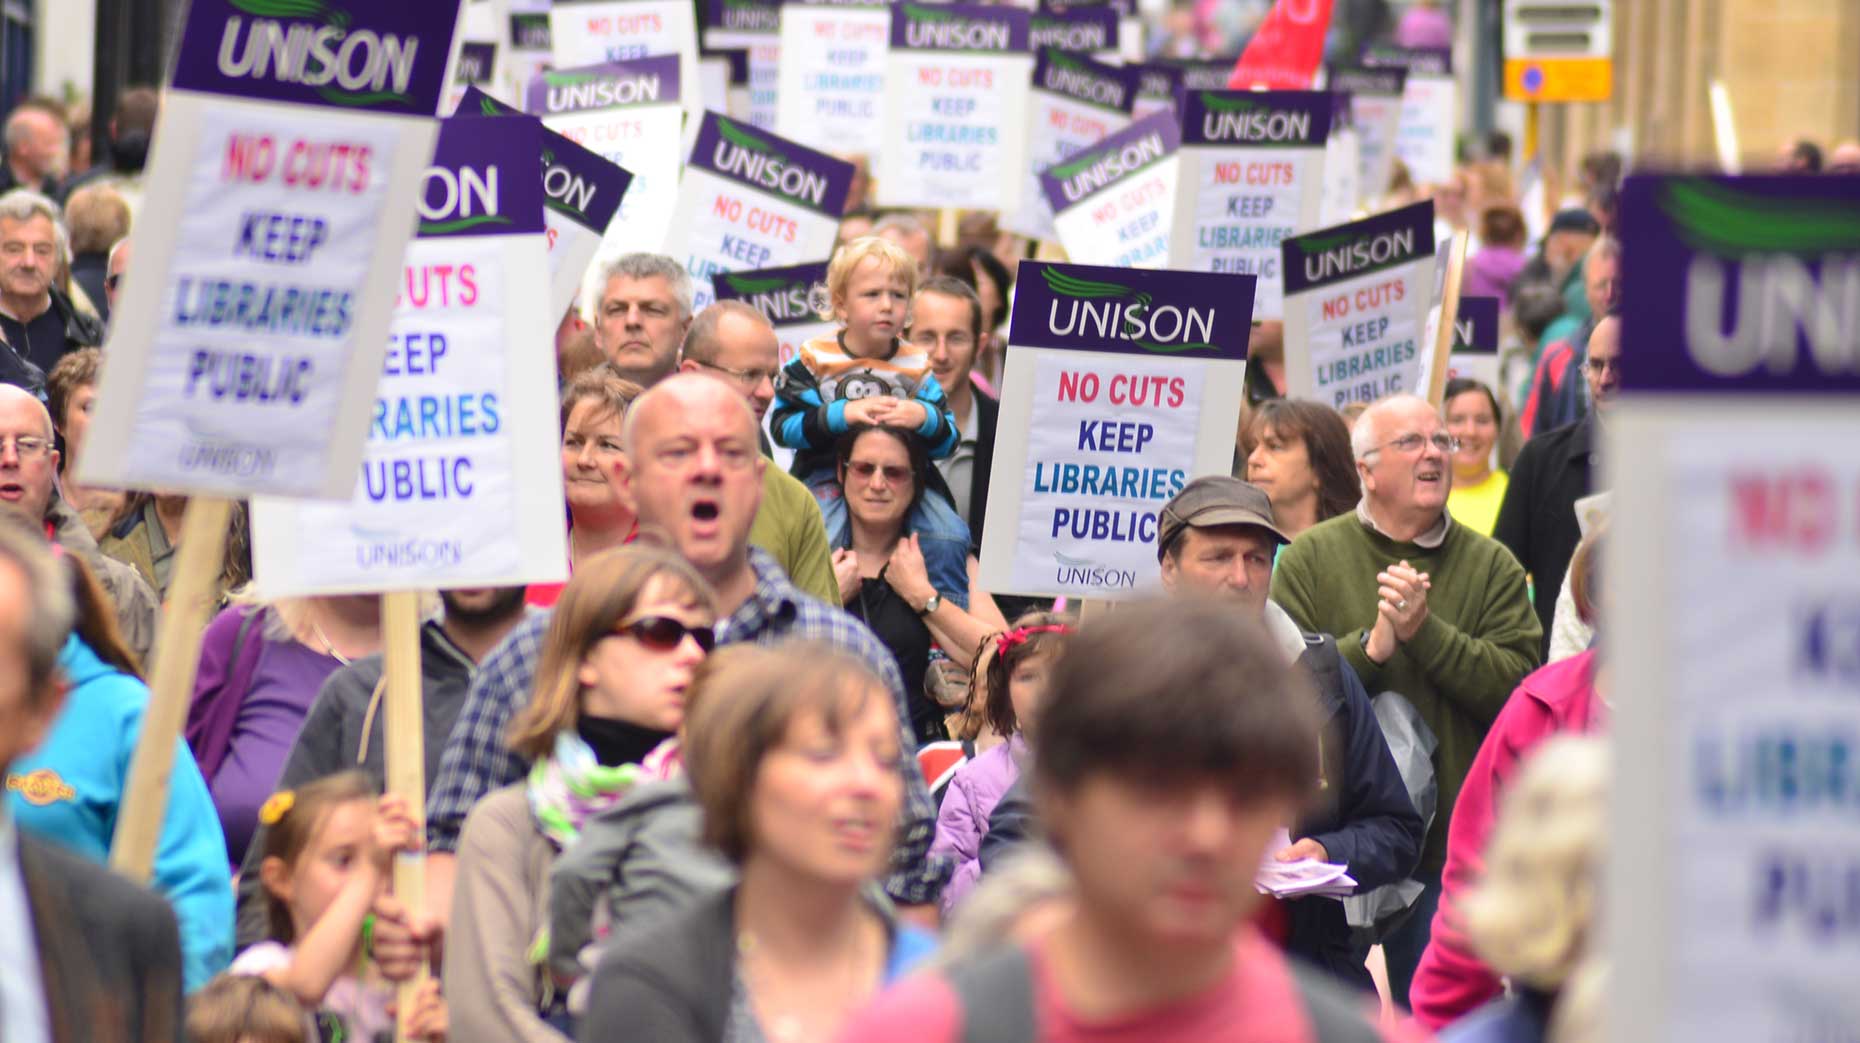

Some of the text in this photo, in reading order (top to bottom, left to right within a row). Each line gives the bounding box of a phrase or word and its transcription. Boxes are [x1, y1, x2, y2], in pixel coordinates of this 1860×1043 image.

[217, 15, 420, 94] UNISON
[906, 21, 1010, 49] UNISON
[1029, 24, 1105, 50] NISON
[547, 75, 661, 112] UNISON
[1046, 64, 1125, 107] UNISON
[1202, 111, 1312, 141] UNISON
[221, 130, 276, 185] NO
[283, 138, 371, 195] CUTS
[713, 141, 828, 205] UNISON
[1062, 129, 1164, 202] UNISON
[1214, 162, 1294, 186] NO CUTS
[713, 195, 798, 243] NO CUTS
[1227, 196, 1274, 218] KEEP
[232, 210, 330, 265] KEEP
[720, 233, 771, 269] KEEP
[1305, 228, 1414, 281] UNISON
[395, 263, 478, 308] UTS
[1322, 279, 1405, 320] NO CUTS
[174, 278, 352, 338] LIBRARIES
[1047, 298, 1216, 344] UNISON
[1342, 317, 1389, 349] KEEP
[384, 334, 447, 375] EEP
[1318, 339, 1415, 387] LIBRARIES
[184, 350, 315, 406] PUBLIC
[1057, 371, 1186, 408] NO CUTS
[368, 392, 500, 439] RARIES
[1078, 420, 1154, 453] KEEP
[362, 457, 473, 501] UBLIC
[1033, 462, 1186, 499] LIBRARIES
[1051, 508, 1157, 543] PUBLIC
[356, 540, 463, 568] UNISON
[1057, 567, 1136, 588] UNISON
